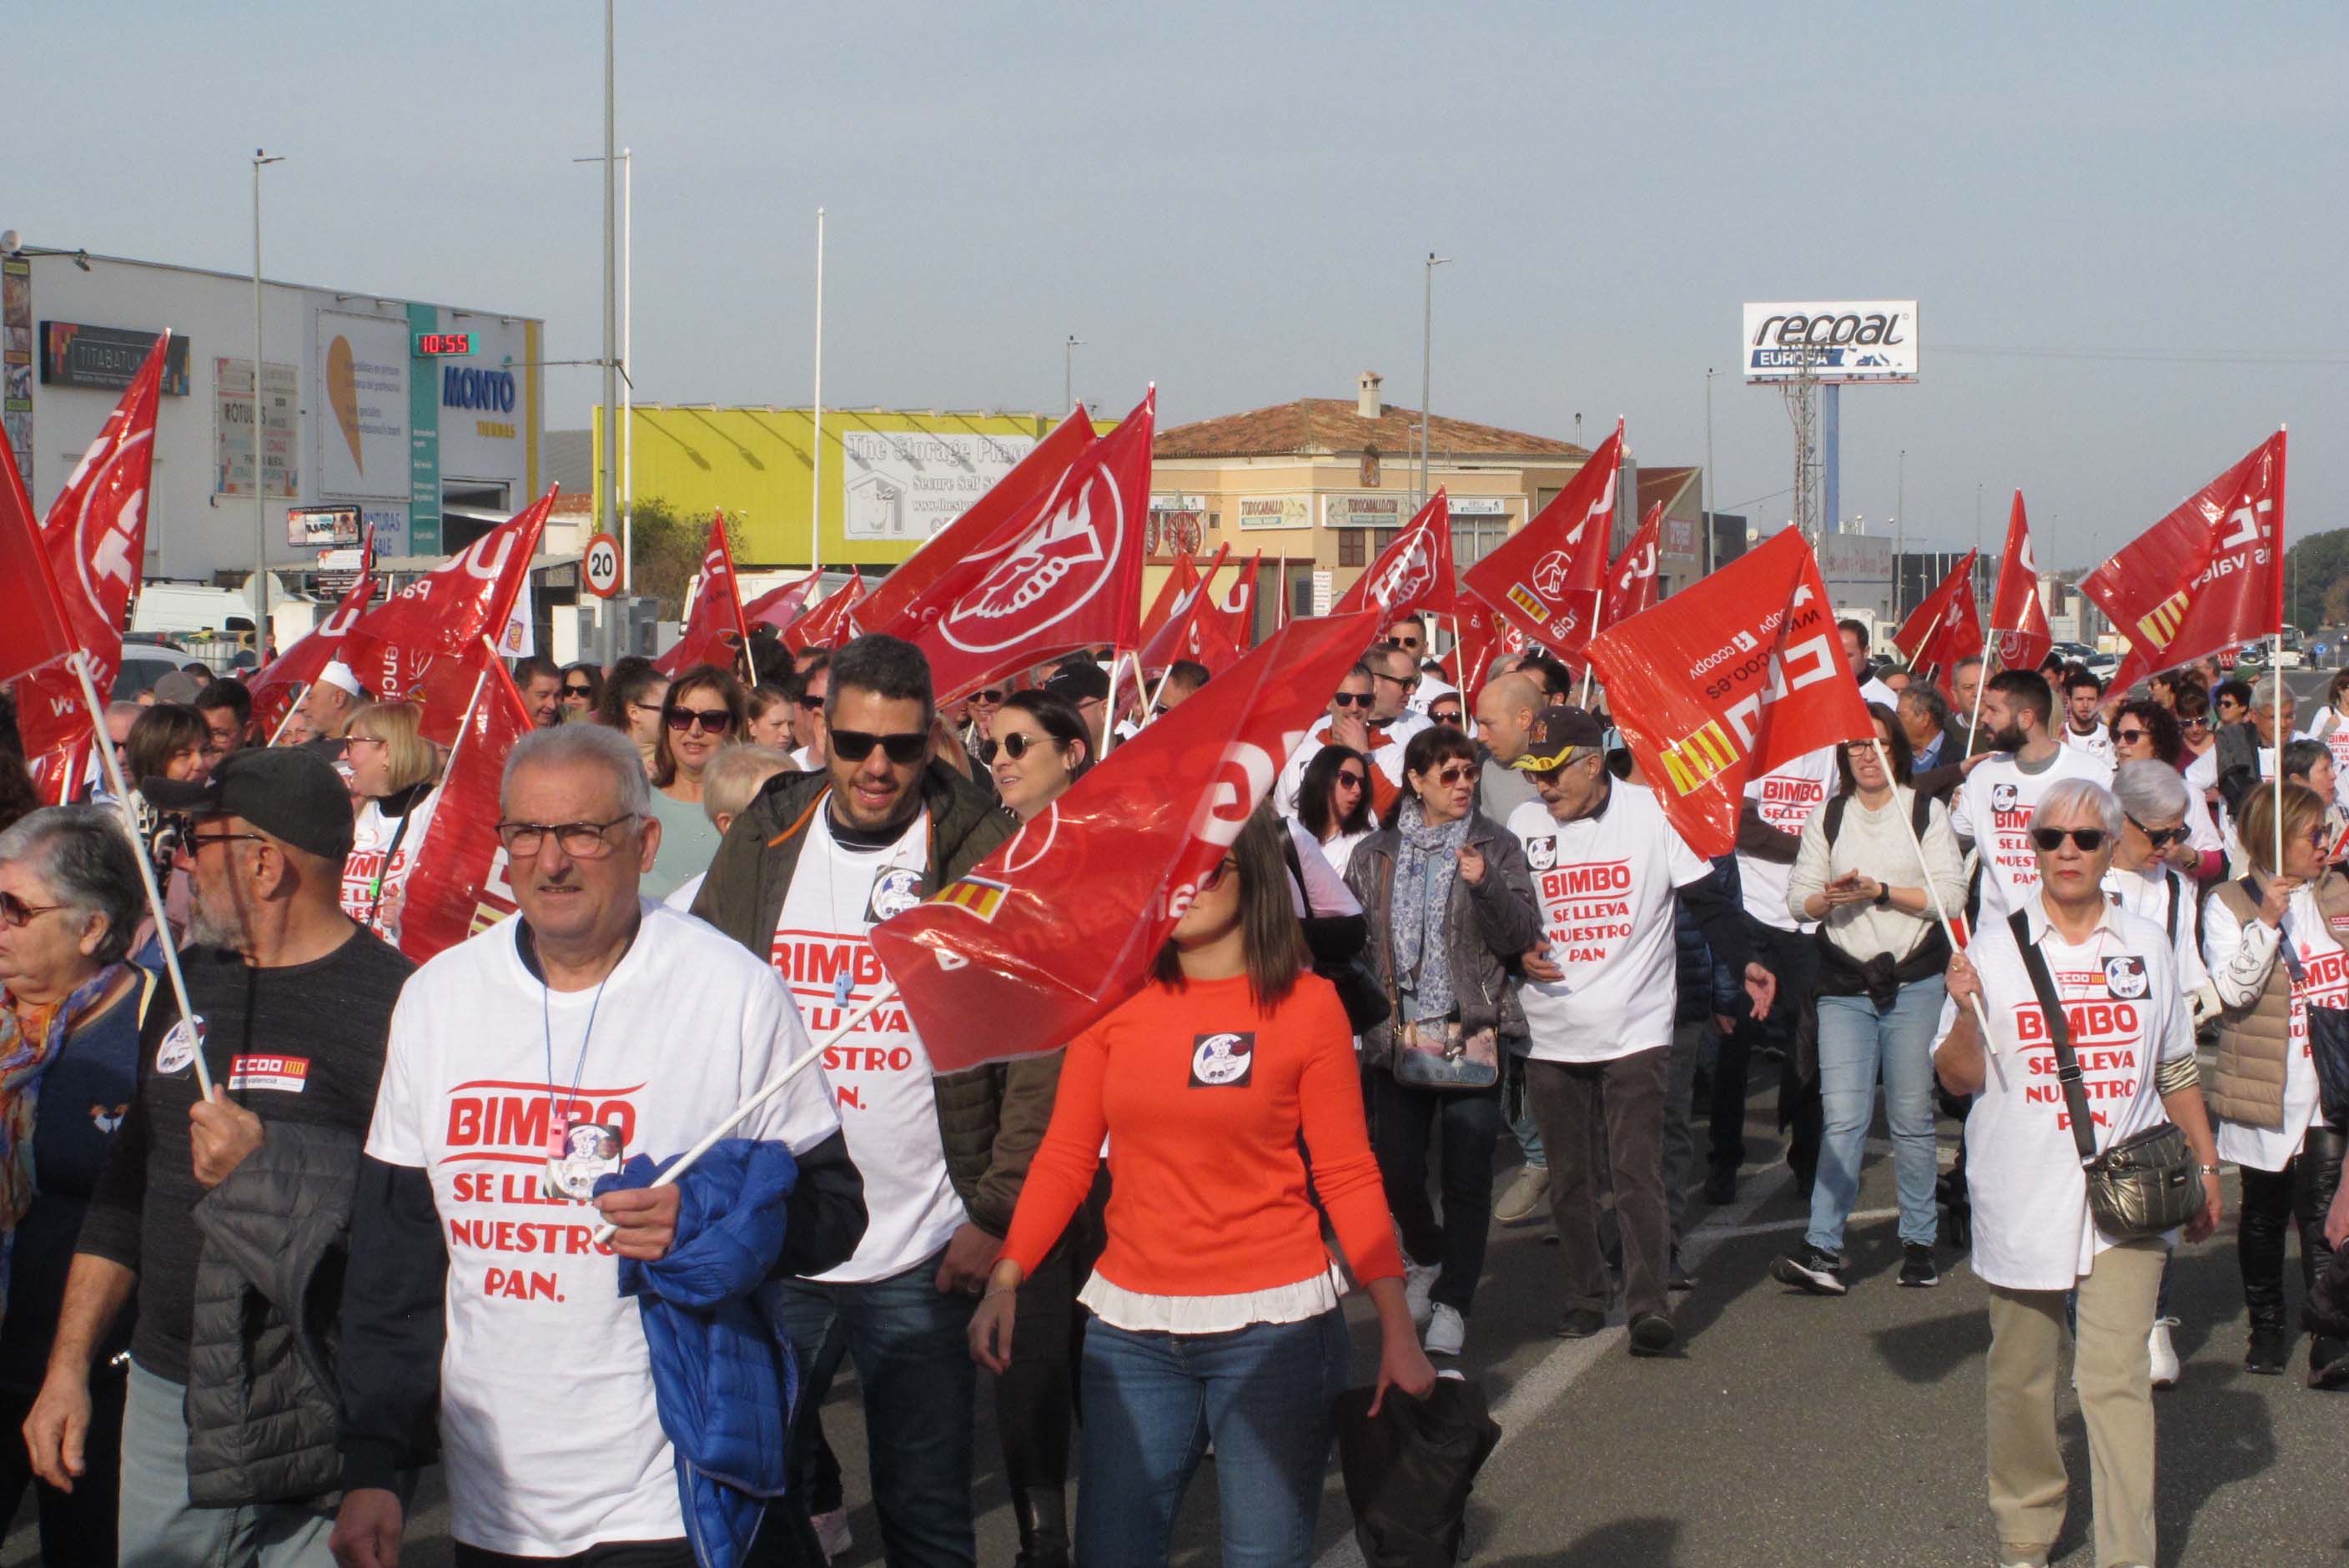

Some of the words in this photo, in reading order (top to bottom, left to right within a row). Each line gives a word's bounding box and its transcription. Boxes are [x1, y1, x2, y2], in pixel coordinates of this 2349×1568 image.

[1756, 314, 1904, 346] recoal
[420, 334, 469, 353] 10:55
[848, 435, 886, 460] The
[894, 435, 970, 466] Storage
[591, 552, 613, 577] 20
[1763, 781, 1823, 802] BIMBO
[1994, 811, 2033, 828] BIM
[1996, 857, 2040, 869] NUEST
[1542, 866, 1631, 898] BIMBO
[1553, 909, 1571, 923] SE
[1573, 902, 1629, 920] LLEVA
[1549, 923, 1632, 942] NUESTRO
[772, 943, 893, 985] BIMB
[235, 1058, 283, 1073] CCOO
[453, 1173, 494, 1202] SE
[485, 1267, 566, 1303] PAN.
